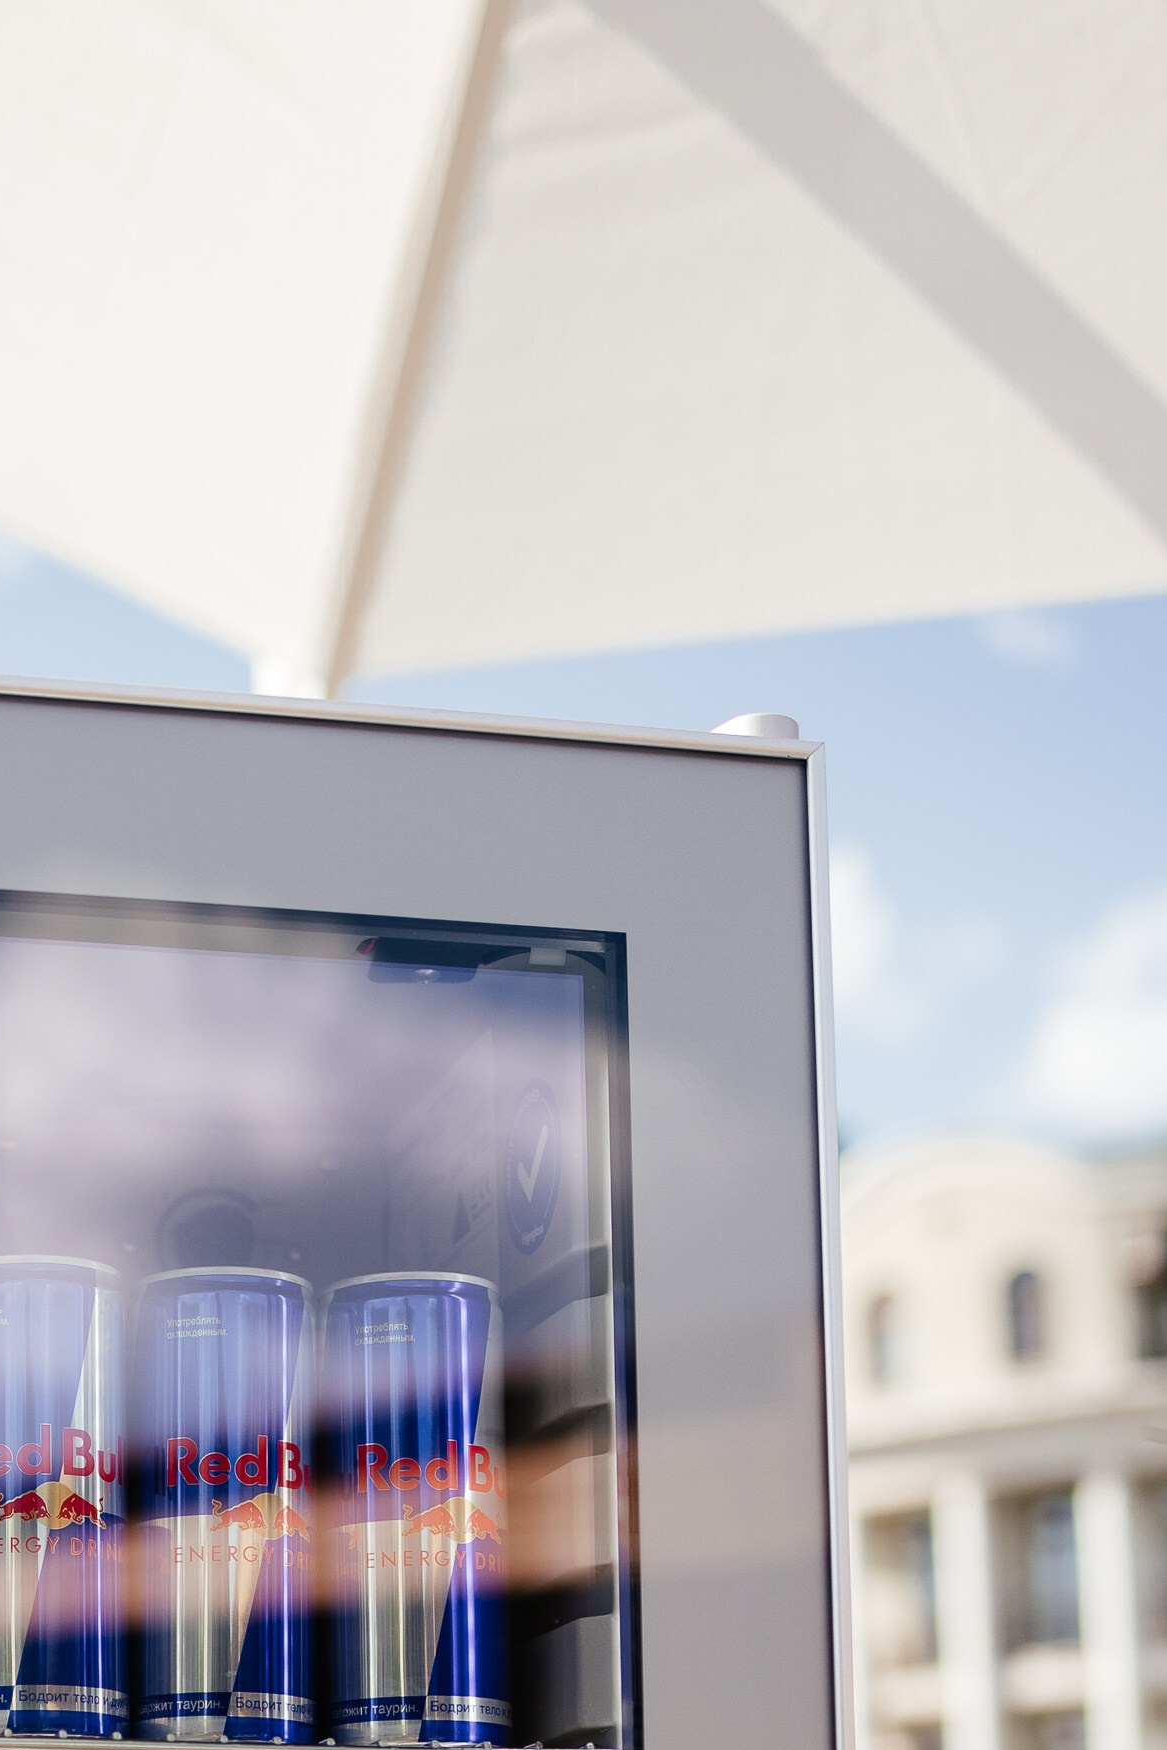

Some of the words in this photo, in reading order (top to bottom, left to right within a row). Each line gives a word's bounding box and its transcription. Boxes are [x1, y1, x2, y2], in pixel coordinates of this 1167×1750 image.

[167, 1316, 221, 1328] Употреблять
[355, 1322, 408, 1335] Употреблять
[166, 1328, 228, 1338] охлажденным.
[355, 1333, 415, 1345] охлажденным.
[166, 1434, 268, 1488] Red
[357, 1438, 459, 1493] Red
[174, 1545, 274, 1565] ENERGY
[366, 1551, 466, 1568] ENERGY
[18, 1689, 69, 1704] Бодрит
[73, 1694, 100, 1705] тело
[235, 1696, 282, 1713] Бодрит
[286, 1701, 307, 1714] тело
[177, 1699, 224, 1712] таурин.
[372, 1703, 419, 1717] таурин.
[430, 1700, 477, 1715] Бодрит
[479, 1704, 501, 1716] тело
